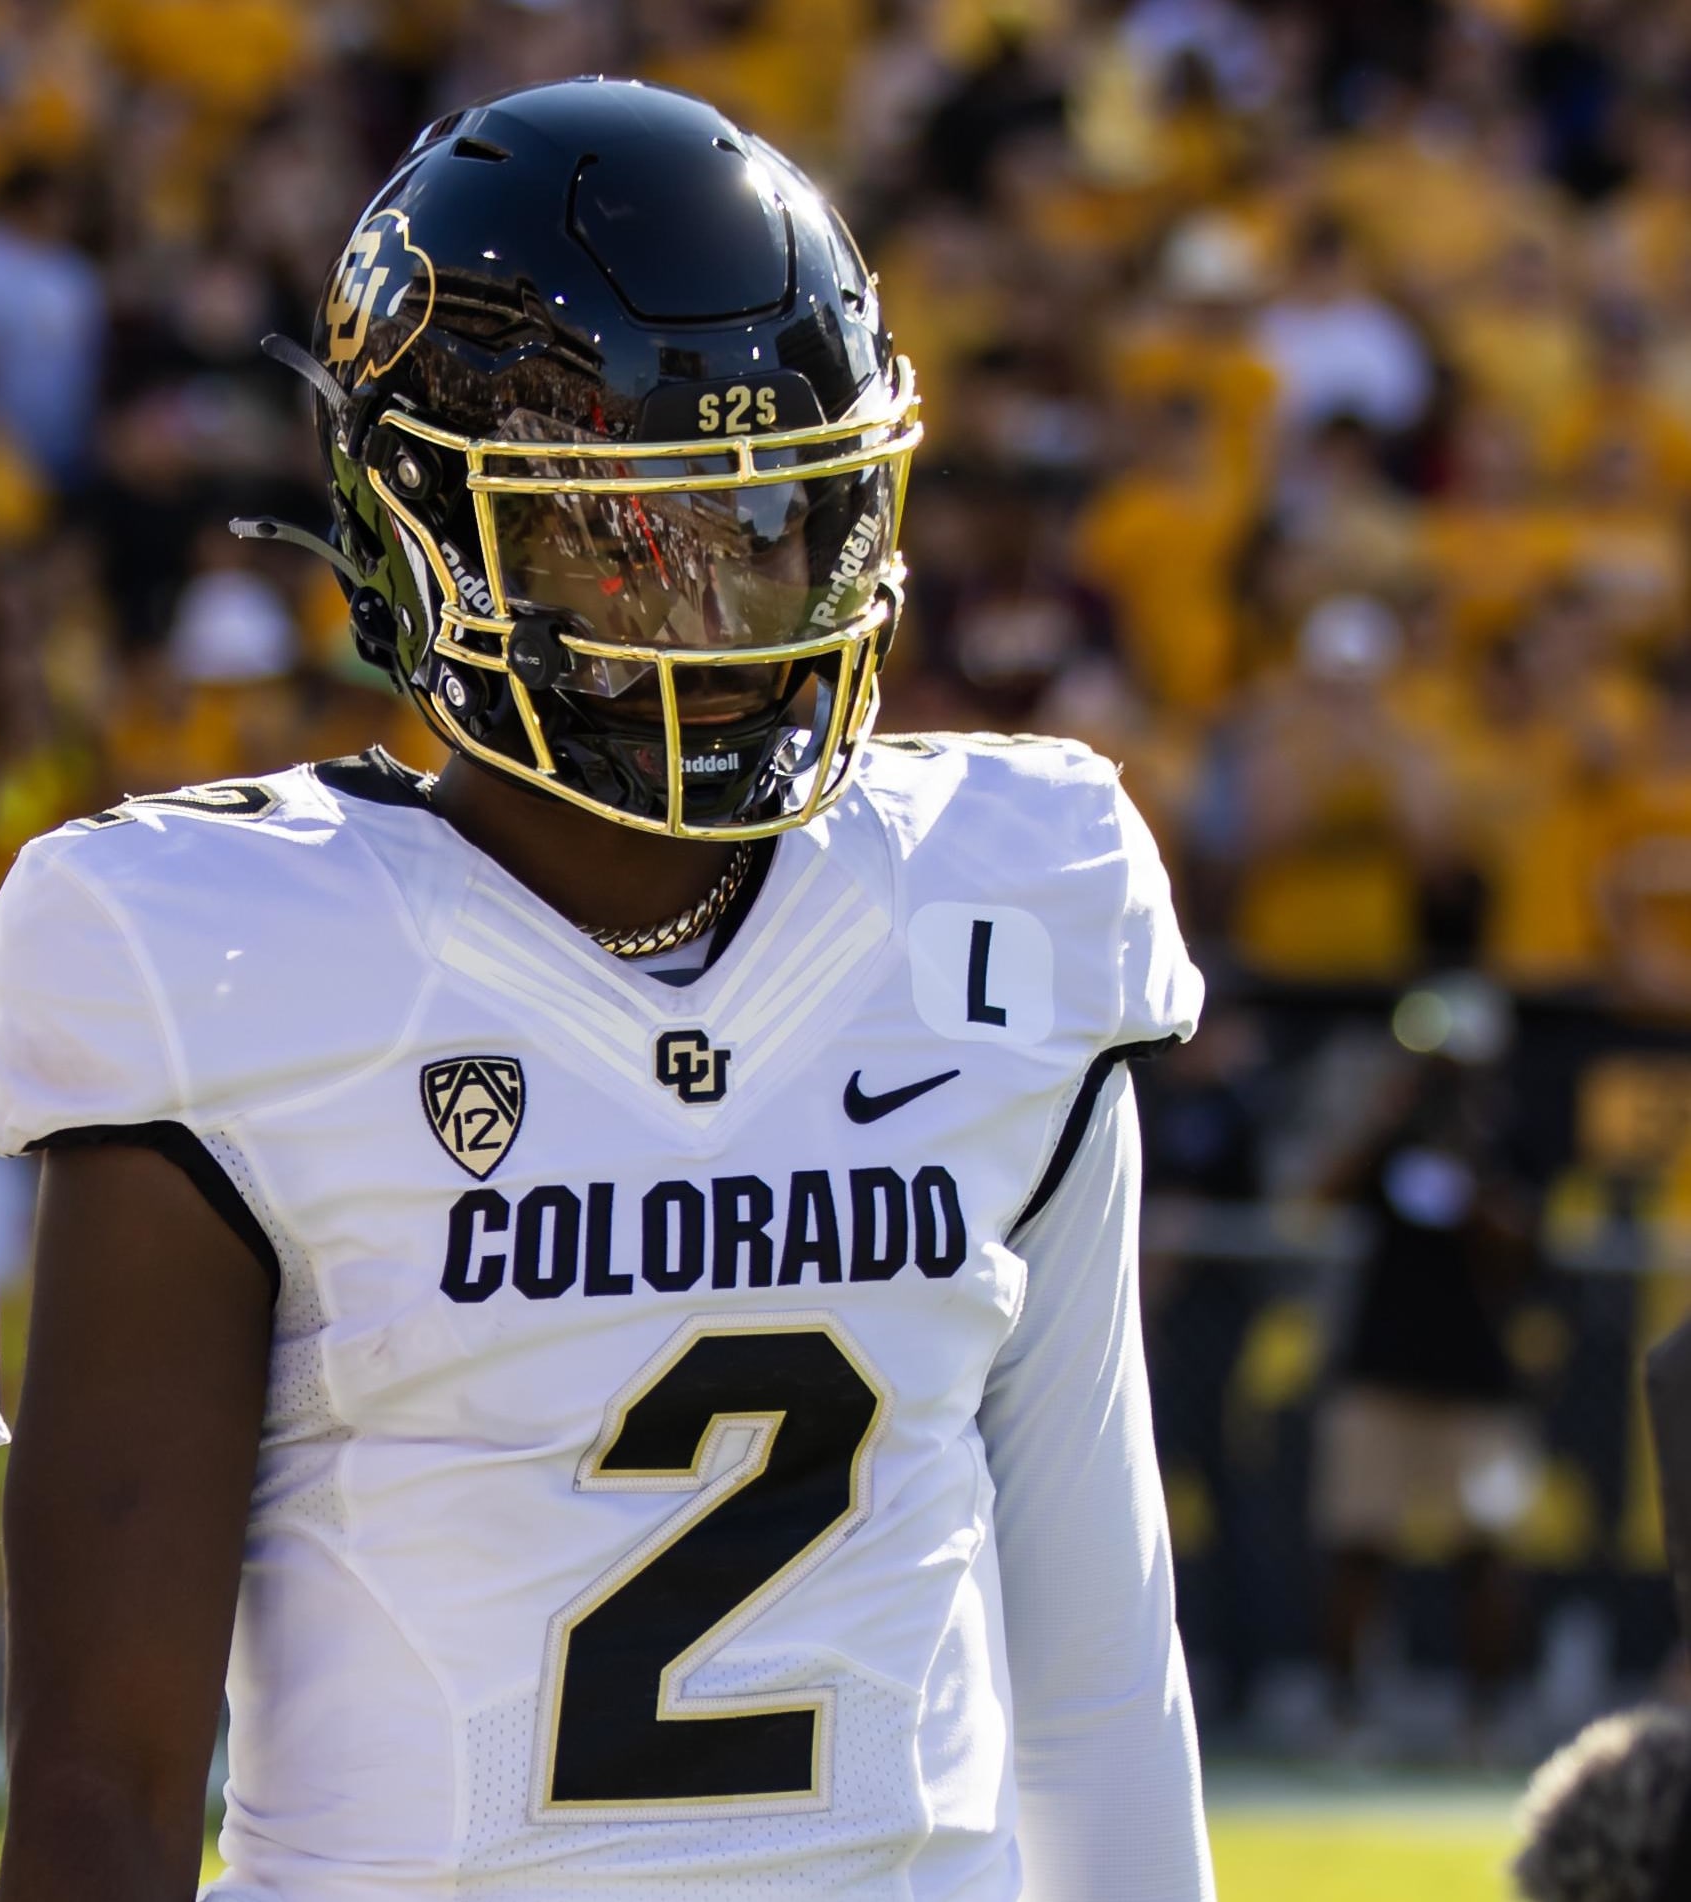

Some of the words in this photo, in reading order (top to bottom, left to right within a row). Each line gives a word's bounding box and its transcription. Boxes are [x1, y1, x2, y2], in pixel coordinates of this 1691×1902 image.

[326, 231, 390, 362] CU
[698, 385, 777, 434] S2S
[810, 512, 881, 628] Riddell
[966, 919, 1007, 1028] L
[426, 1060, 519, 1133] PAC
[654, 1028, 732, 1104] CU
[452, 1107, 503, 1153] 12
[440, 1164, 968, 1304] COLORADO
[527, 1310, 893, 1826] 2
